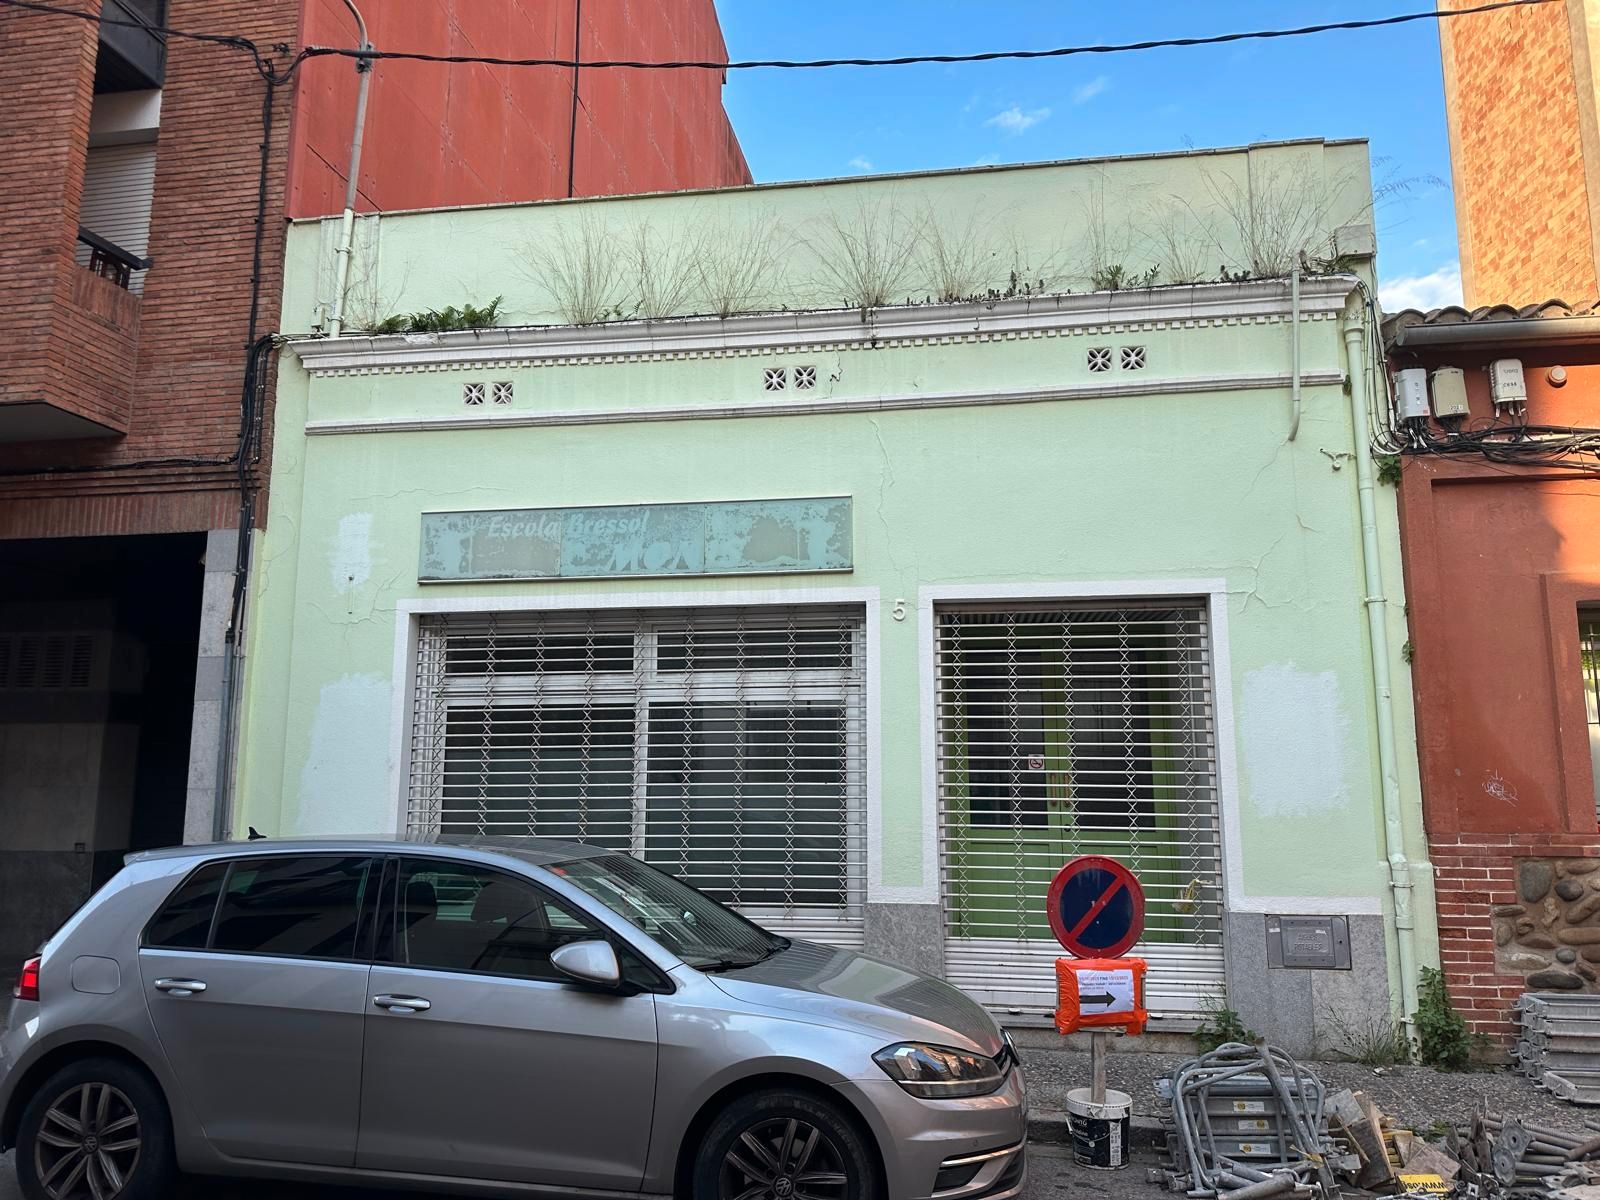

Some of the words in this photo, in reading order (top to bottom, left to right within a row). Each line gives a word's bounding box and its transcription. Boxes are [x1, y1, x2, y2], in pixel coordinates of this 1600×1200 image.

[487, 514, 560, 538] Escola
[568, 509, 650, 536] Bressol
[893, 599, 906, 622] 5
